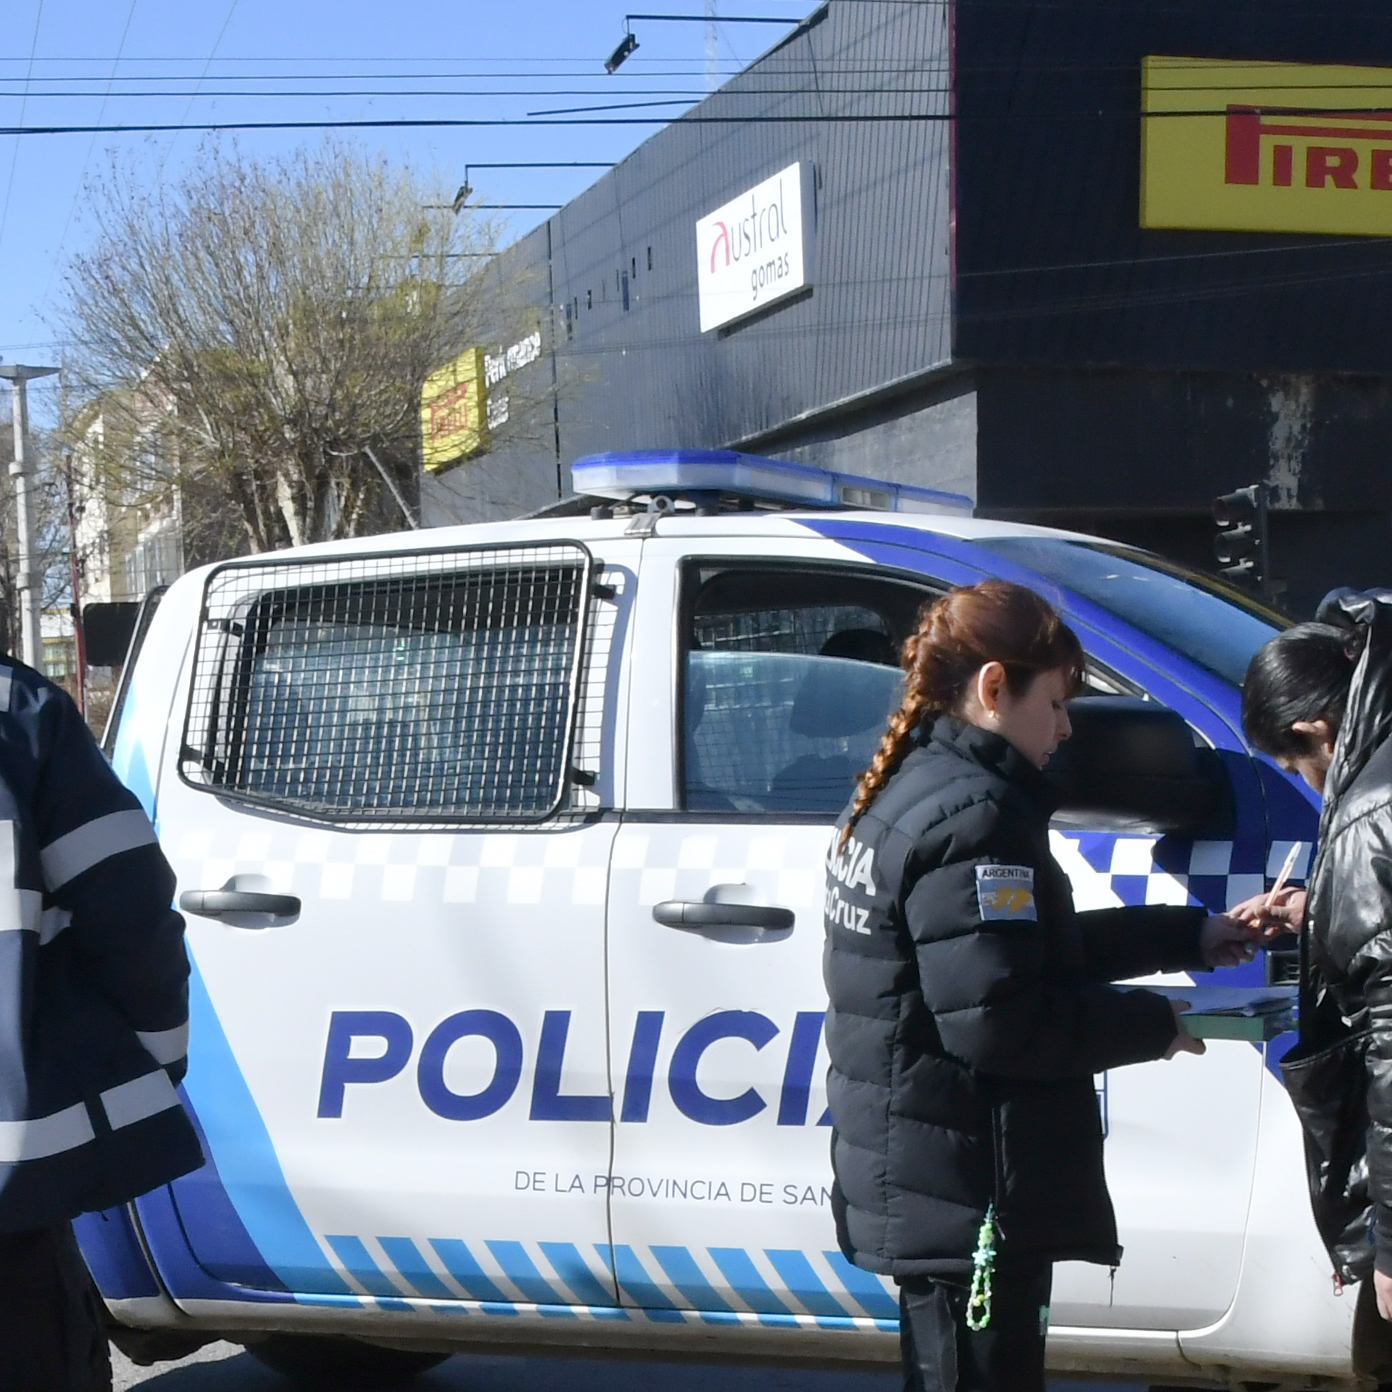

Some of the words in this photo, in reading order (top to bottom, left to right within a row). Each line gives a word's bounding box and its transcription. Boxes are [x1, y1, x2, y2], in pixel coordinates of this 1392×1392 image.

[710, 178, 788, 274] Austral
[751, 252, 790, 301] gomas
[830, 886, 872, 935] Cruz
[317, 1009, 834, 1127] POLICI
[514, 1170, 547, 1191] DE
[554, 1172, 585, 1194] LA
[593, 1174, 732, 1202] PROVINCIA
[740, 1182, 775, 1204] DE
